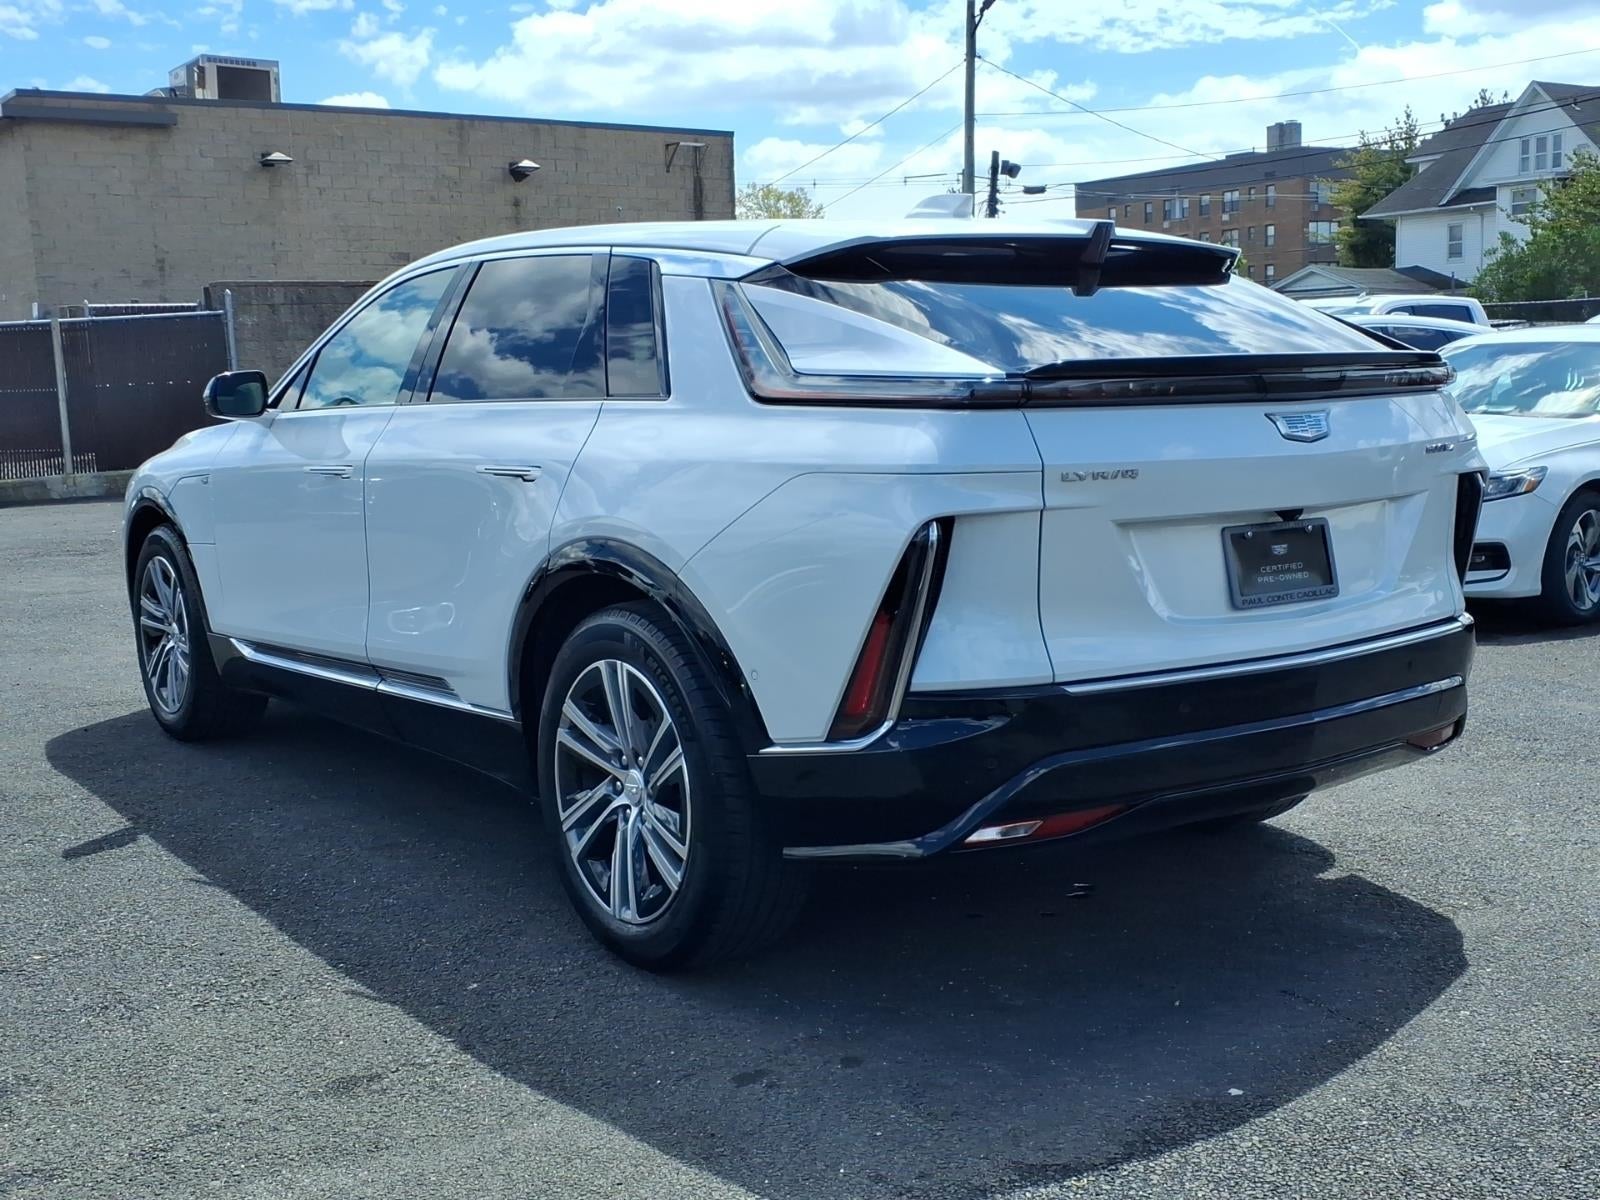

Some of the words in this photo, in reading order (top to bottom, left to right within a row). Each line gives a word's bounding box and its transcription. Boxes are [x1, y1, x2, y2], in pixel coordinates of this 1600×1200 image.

[1260, 561, 1304, 574] CERTIFIED
[1257, 571, 1310, 584] PRE-OWNED
[1241, 597, 1264, 606] PAUL
[1266, 592, 1296, 603] CONTE
[1297, 587, 1336, 599] CADILLAC
